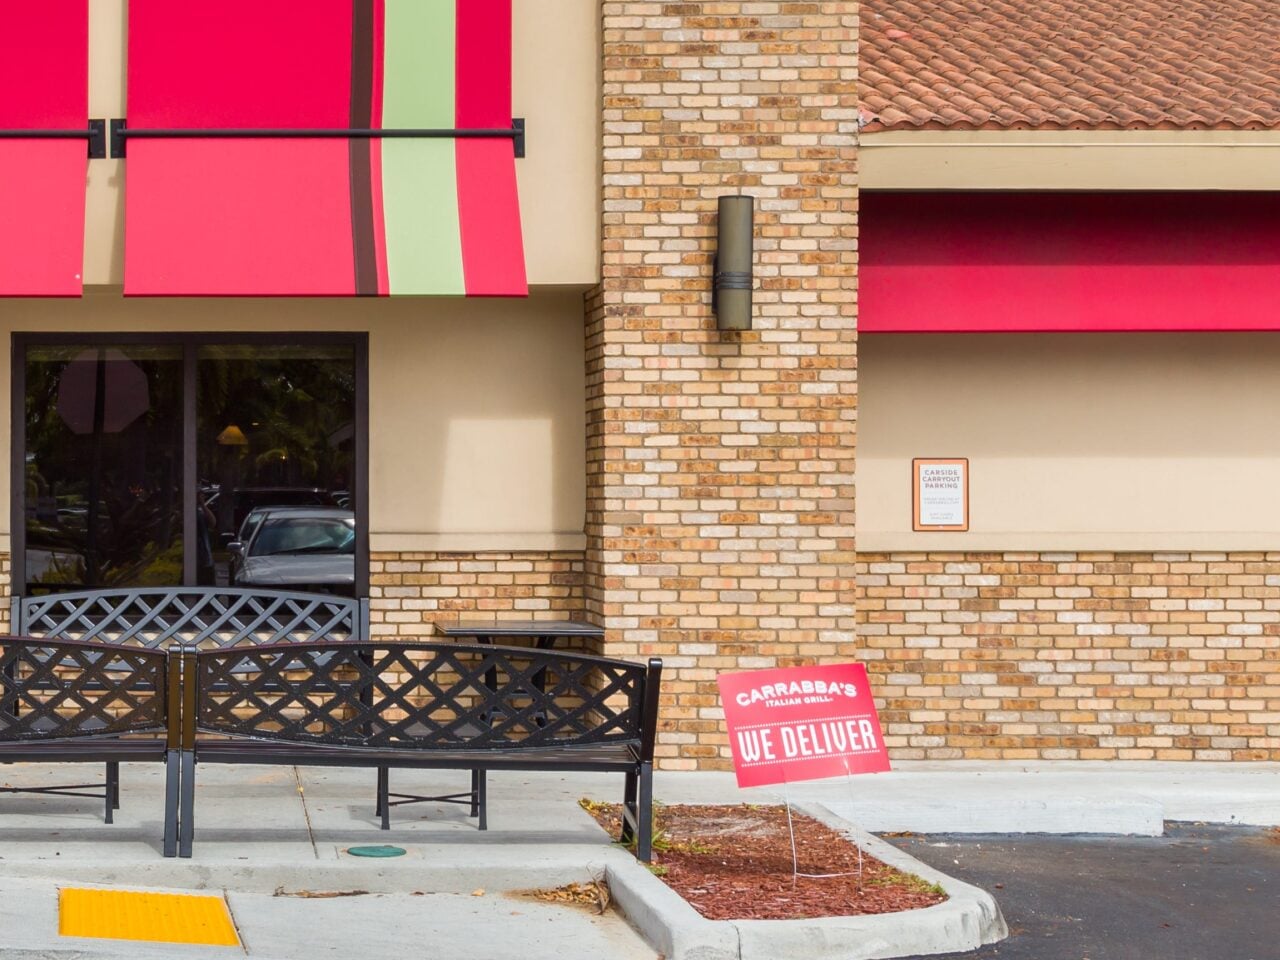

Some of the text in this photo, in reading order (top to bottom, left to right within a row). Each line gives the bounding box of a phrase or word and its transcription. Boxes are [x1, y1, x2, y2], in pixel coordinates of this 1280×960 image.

[736, 680, 857, 707] CARRABBA'S
[766, 697, 801, 707] ITALIAN
[737, 719, 878, 762] WE DELIVER
